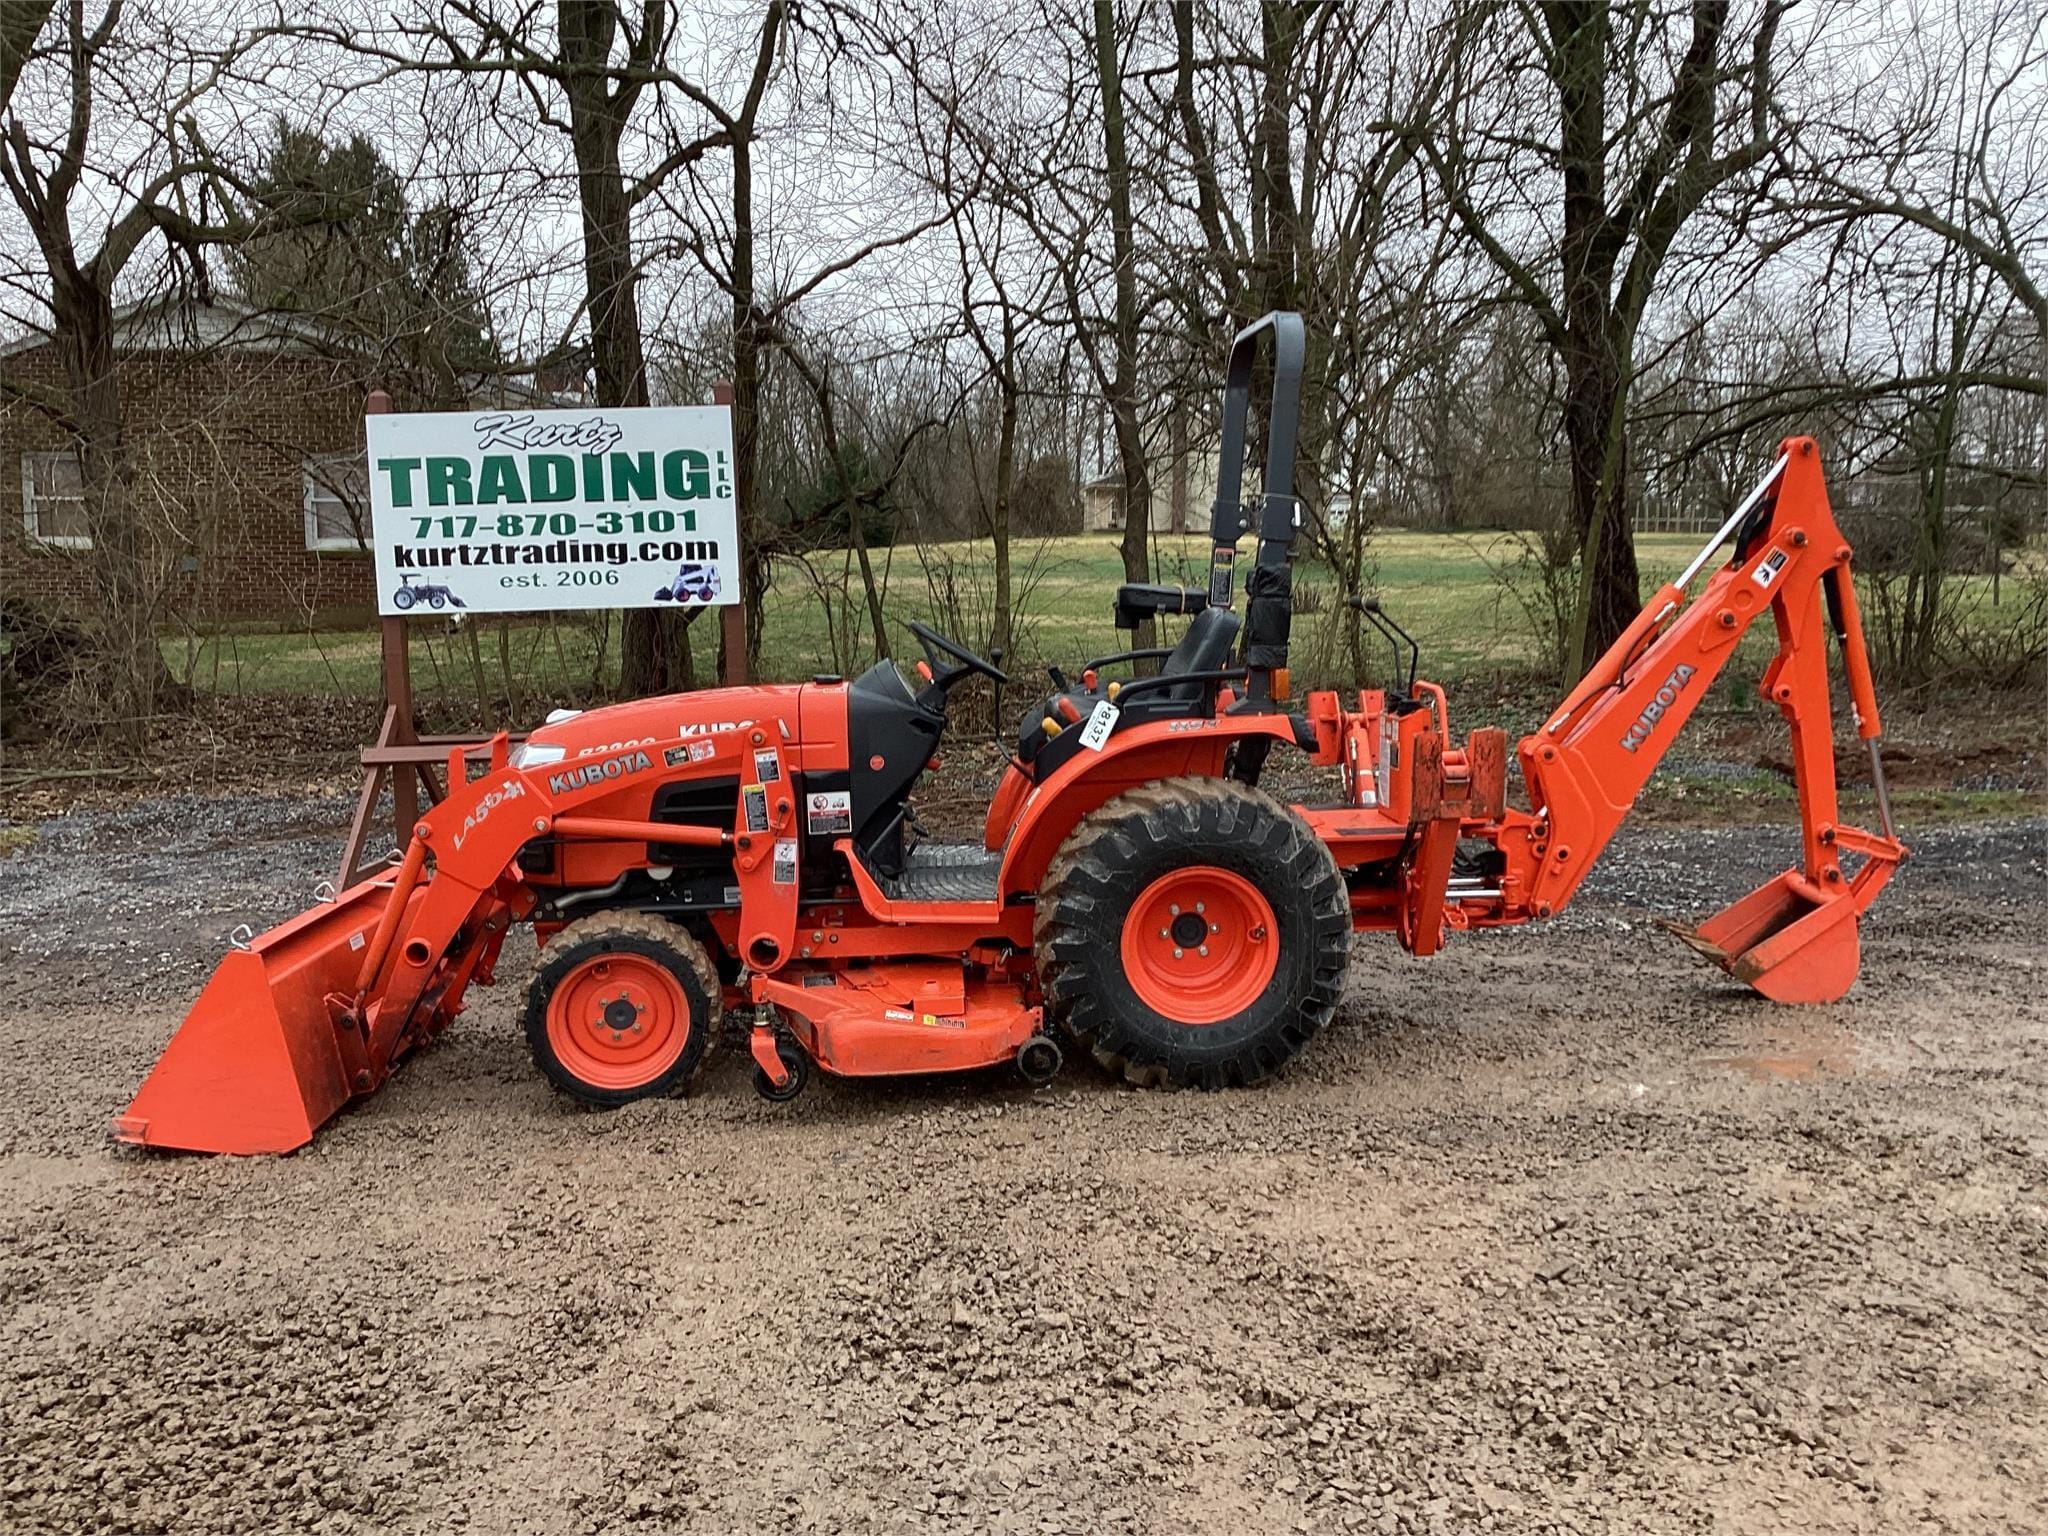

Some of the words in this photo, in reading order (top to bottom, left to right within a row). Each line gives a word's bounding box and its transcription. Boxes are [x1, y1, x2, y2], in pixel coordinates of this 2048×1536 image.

[474, 414, 622, 456] Kurtz
[377, 449, 711, 508] TRADING
[716, 450, 732, 499] LLC
[410, 509, 697, 539] 717-870-3101
[393, 539, 719, 568] kurtztrading.com
[499, 572, 548, 588] est.
[557, 570, 620, 587] 2006
[1090, 710, 1111, 743] 8137
[1619, 662, 1698, 754] KUBOTA
[549, 751, 655, 795] KUBOTA
